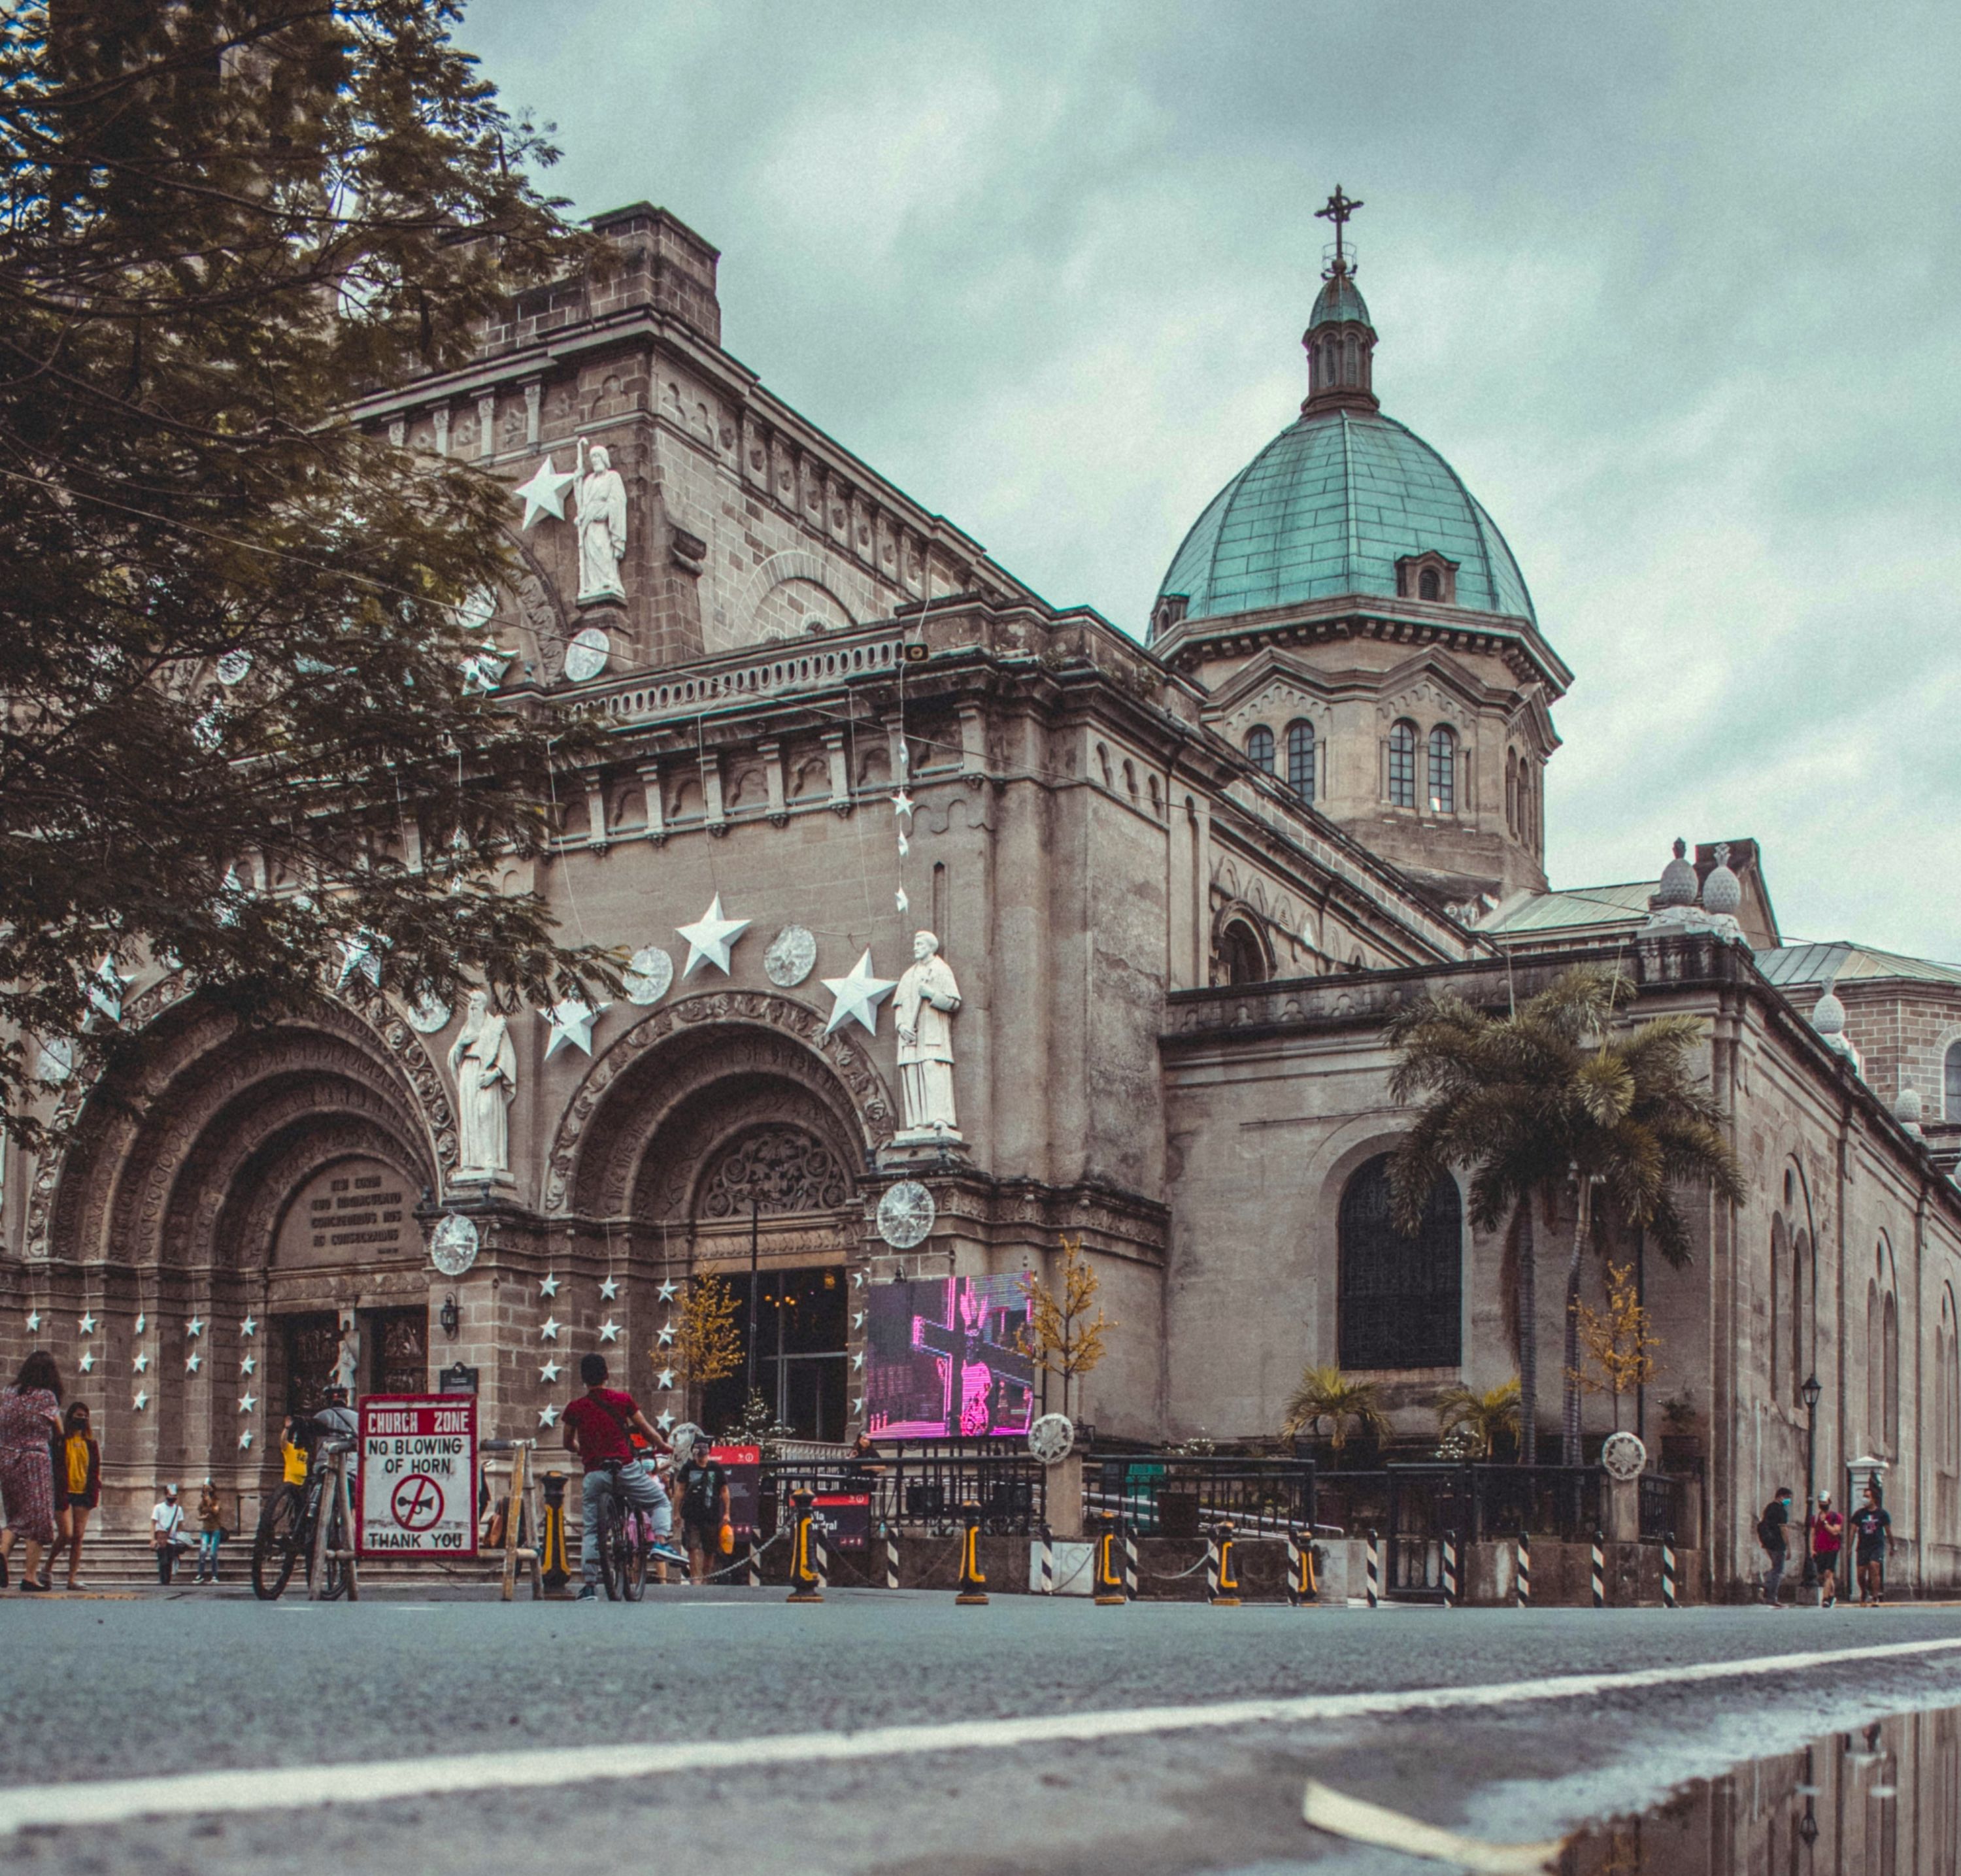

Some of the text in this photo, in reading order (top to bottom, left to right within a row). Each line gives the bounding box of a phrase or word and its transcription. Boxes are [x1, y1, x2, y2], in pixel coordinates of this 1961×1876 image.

[368, 1411, 469, 1433] CHURCH ZONE
[369, 1438, 463, 1455] NO BLOWING
[385, 1459, 450, 1473] OF HORN
[369, 1533, 462, 1548] THANK YOU
